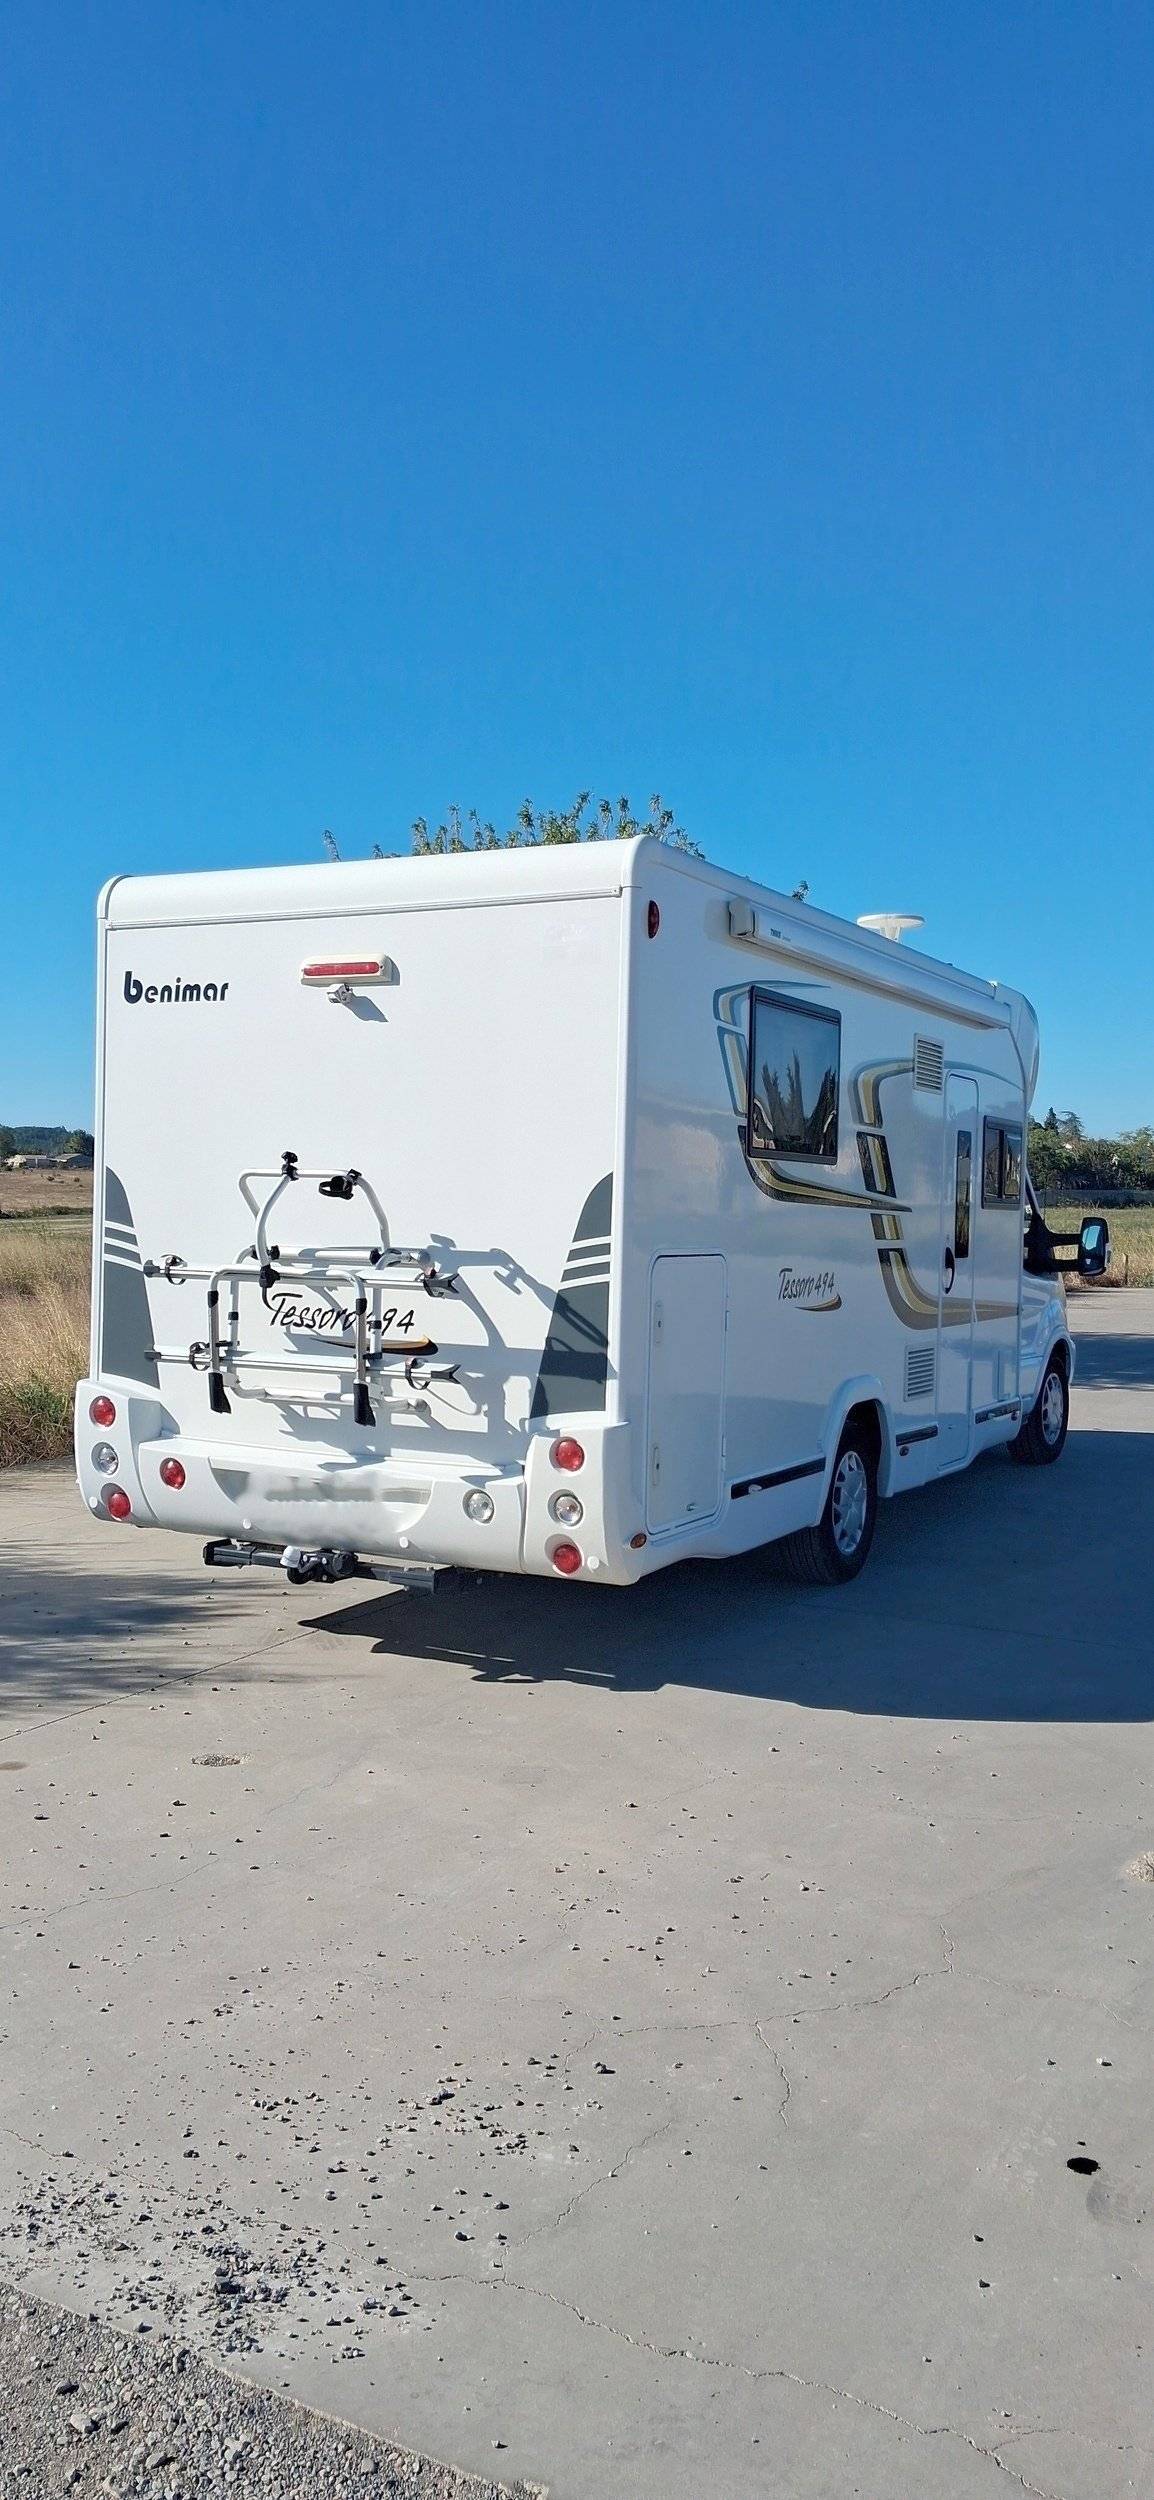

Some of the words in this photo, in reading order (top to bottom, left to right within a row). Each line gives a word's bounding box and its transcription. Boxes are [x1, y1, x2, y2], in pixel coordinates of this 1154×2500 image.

[124, 971, 229, 1004] benimar
[778, 1268, 814, 1300] Tessoro
[815, 1272, 835, 1298] 494
[270, 1292, 358, 1331] Tessoro
